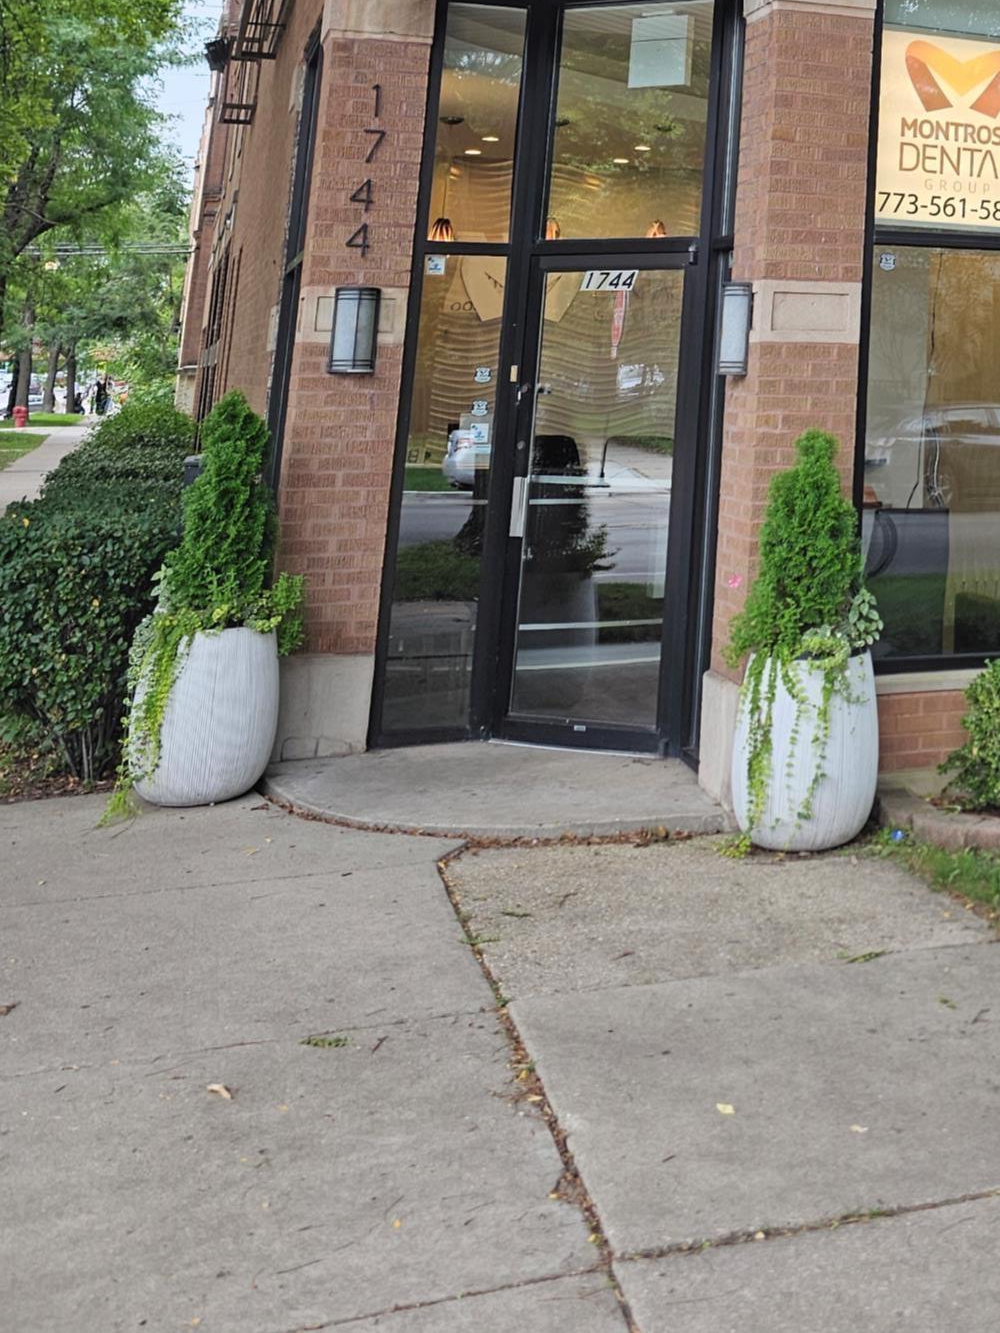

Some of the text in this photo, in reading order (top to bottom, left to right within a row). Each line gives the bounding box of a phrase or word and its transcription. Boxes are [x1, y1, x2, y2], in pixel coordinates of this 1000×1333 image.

[345, 83, 387, 258] 1744
[924, 178, 991, 194] GROUP
[586, 272, 636, 290] 1744
